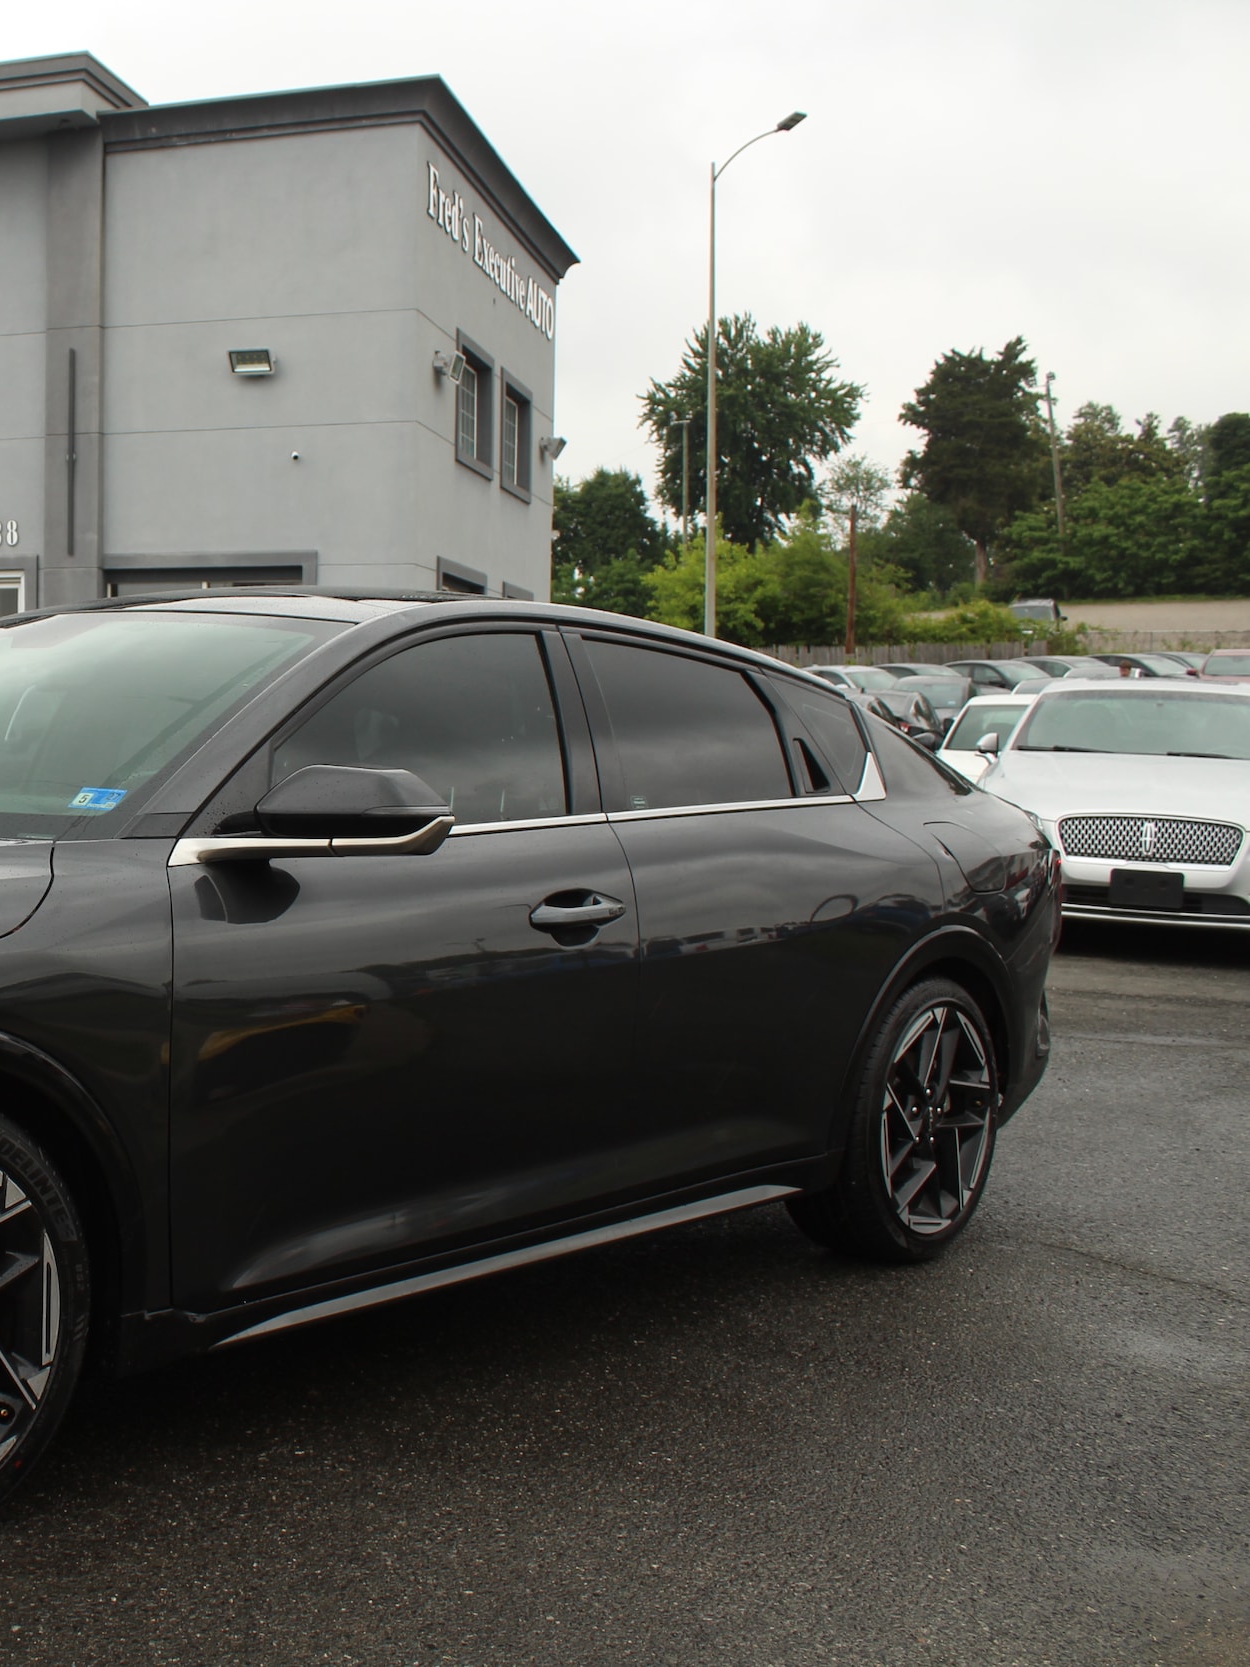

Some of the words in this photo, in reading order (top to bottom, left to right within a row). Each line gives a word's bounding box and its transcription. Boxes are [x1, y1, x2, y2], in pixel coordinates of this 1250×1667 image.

[427, 160, 469, 252] Fred's
[473, 212, 526, 311] Executive
[525, 276, 554, 341] AUTO
